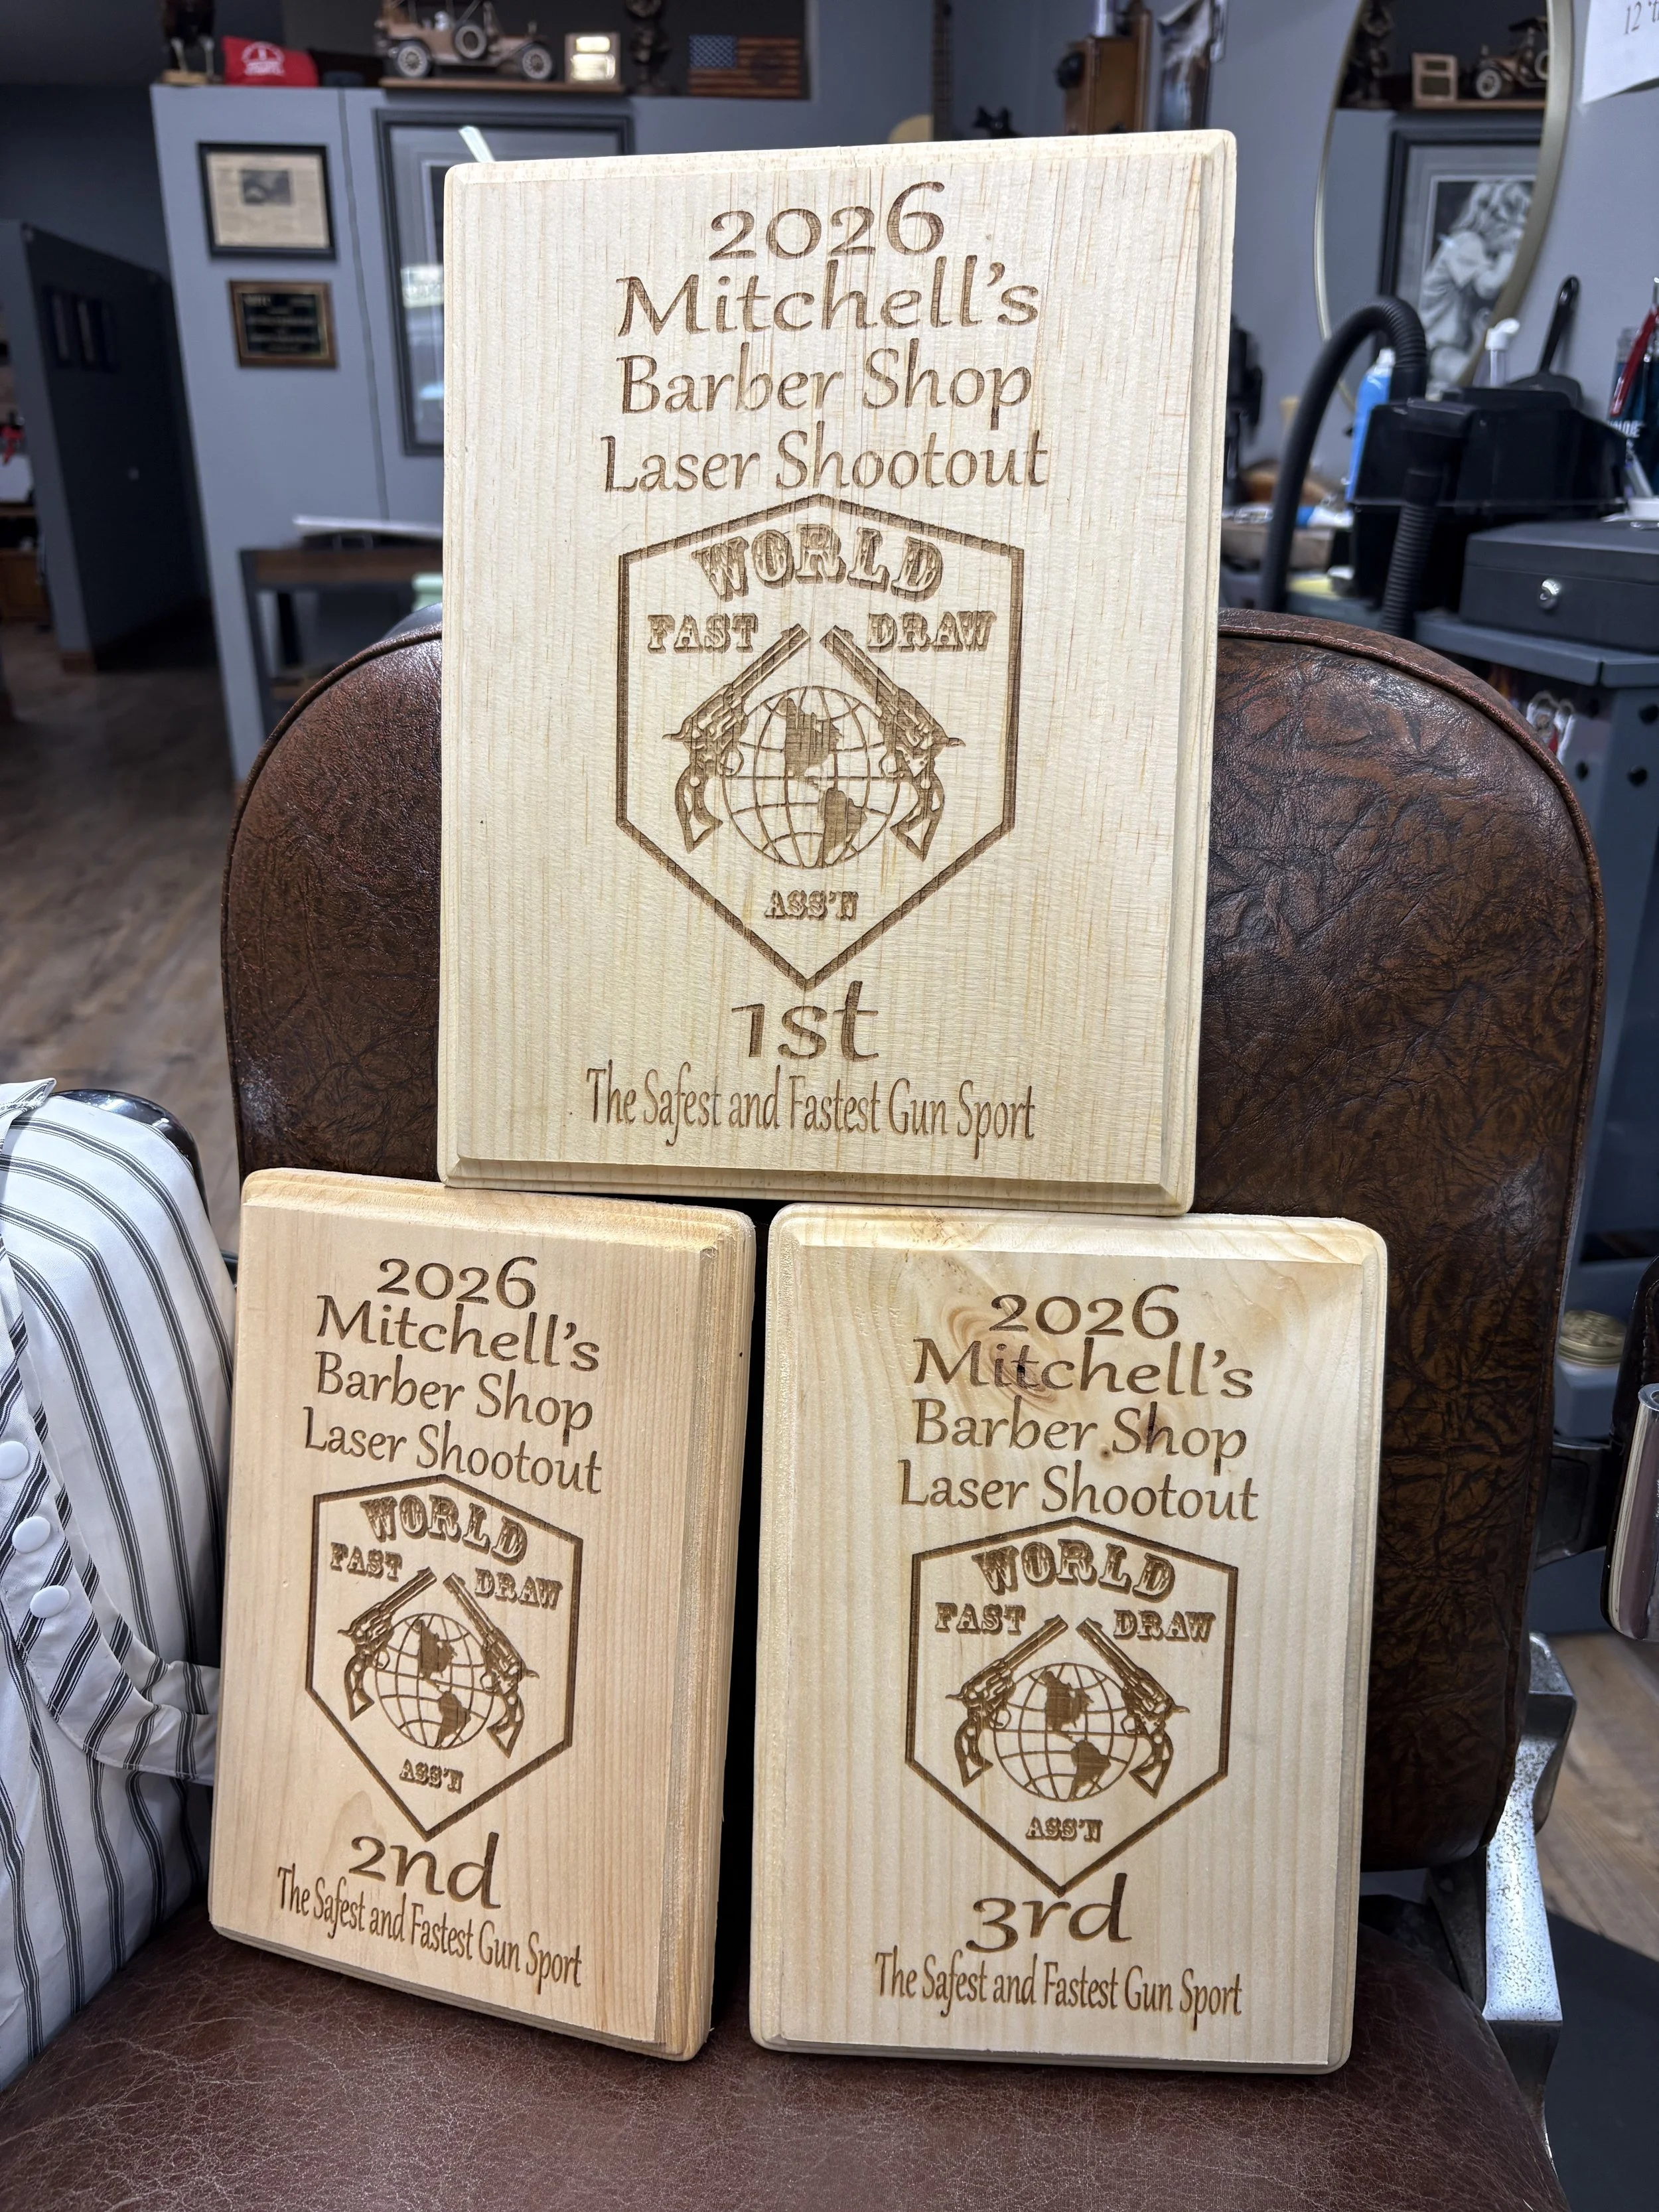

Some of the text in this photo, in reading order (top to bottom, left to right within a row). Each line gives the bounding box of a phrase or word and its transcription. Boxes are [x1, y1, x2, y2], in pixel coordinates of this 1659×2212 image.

[708, 182, 945, 261] 2026
[616, 255, 1039, 336] Mitchell's
[616, 338, 1032, 430] Barber Shop
[601, 421, 1048, 492] Laser Shootout
[691, 523, 944, 601] WORLD
[647, 611, 996, 653] FAST DRAW
[764, 890, 859, 921] ASS'N
[731, 980, 879, 1062] 1st
[587, 1059, 1035, 1159] The Safest and Fastest Gun Sport
[378, 1256, 538, 1309] 2026
[989, 1284, 1179, 1339] 2026
[317, 1295, 600, 1372] Mitchell's
[912, 1337, 1254, 1398] Mitchell's
[315, 1351, 593, 1447] Barber Shop
[912, 1394, 1246, 1476] Barber Shop
[303, 1406, 602, 1494] Laser Shootout
[898, 1459, 1259, 1521] Laser Shootout
[360, 1494, 528, 1566] WORLD
[330, 1542, 563, 1610] FAST DRAW
[972, 1538, 1176, 1603] WORLD
[935, 1601, 1216, 1643] FAST DRAW
[399, 1759, 464, 1794] ASS'N
[1025, 1816, 1104, 1843] ASS'N
[348, 1832, 501, 1909] 2nd
[277, 1863, 582, 1994] The Safest and Fastest Gun Sport
[966, 1872, 1132, 1953] 3rd
[875, 1945, 1242, 2031] The Safest and Fastest Gun Sport
